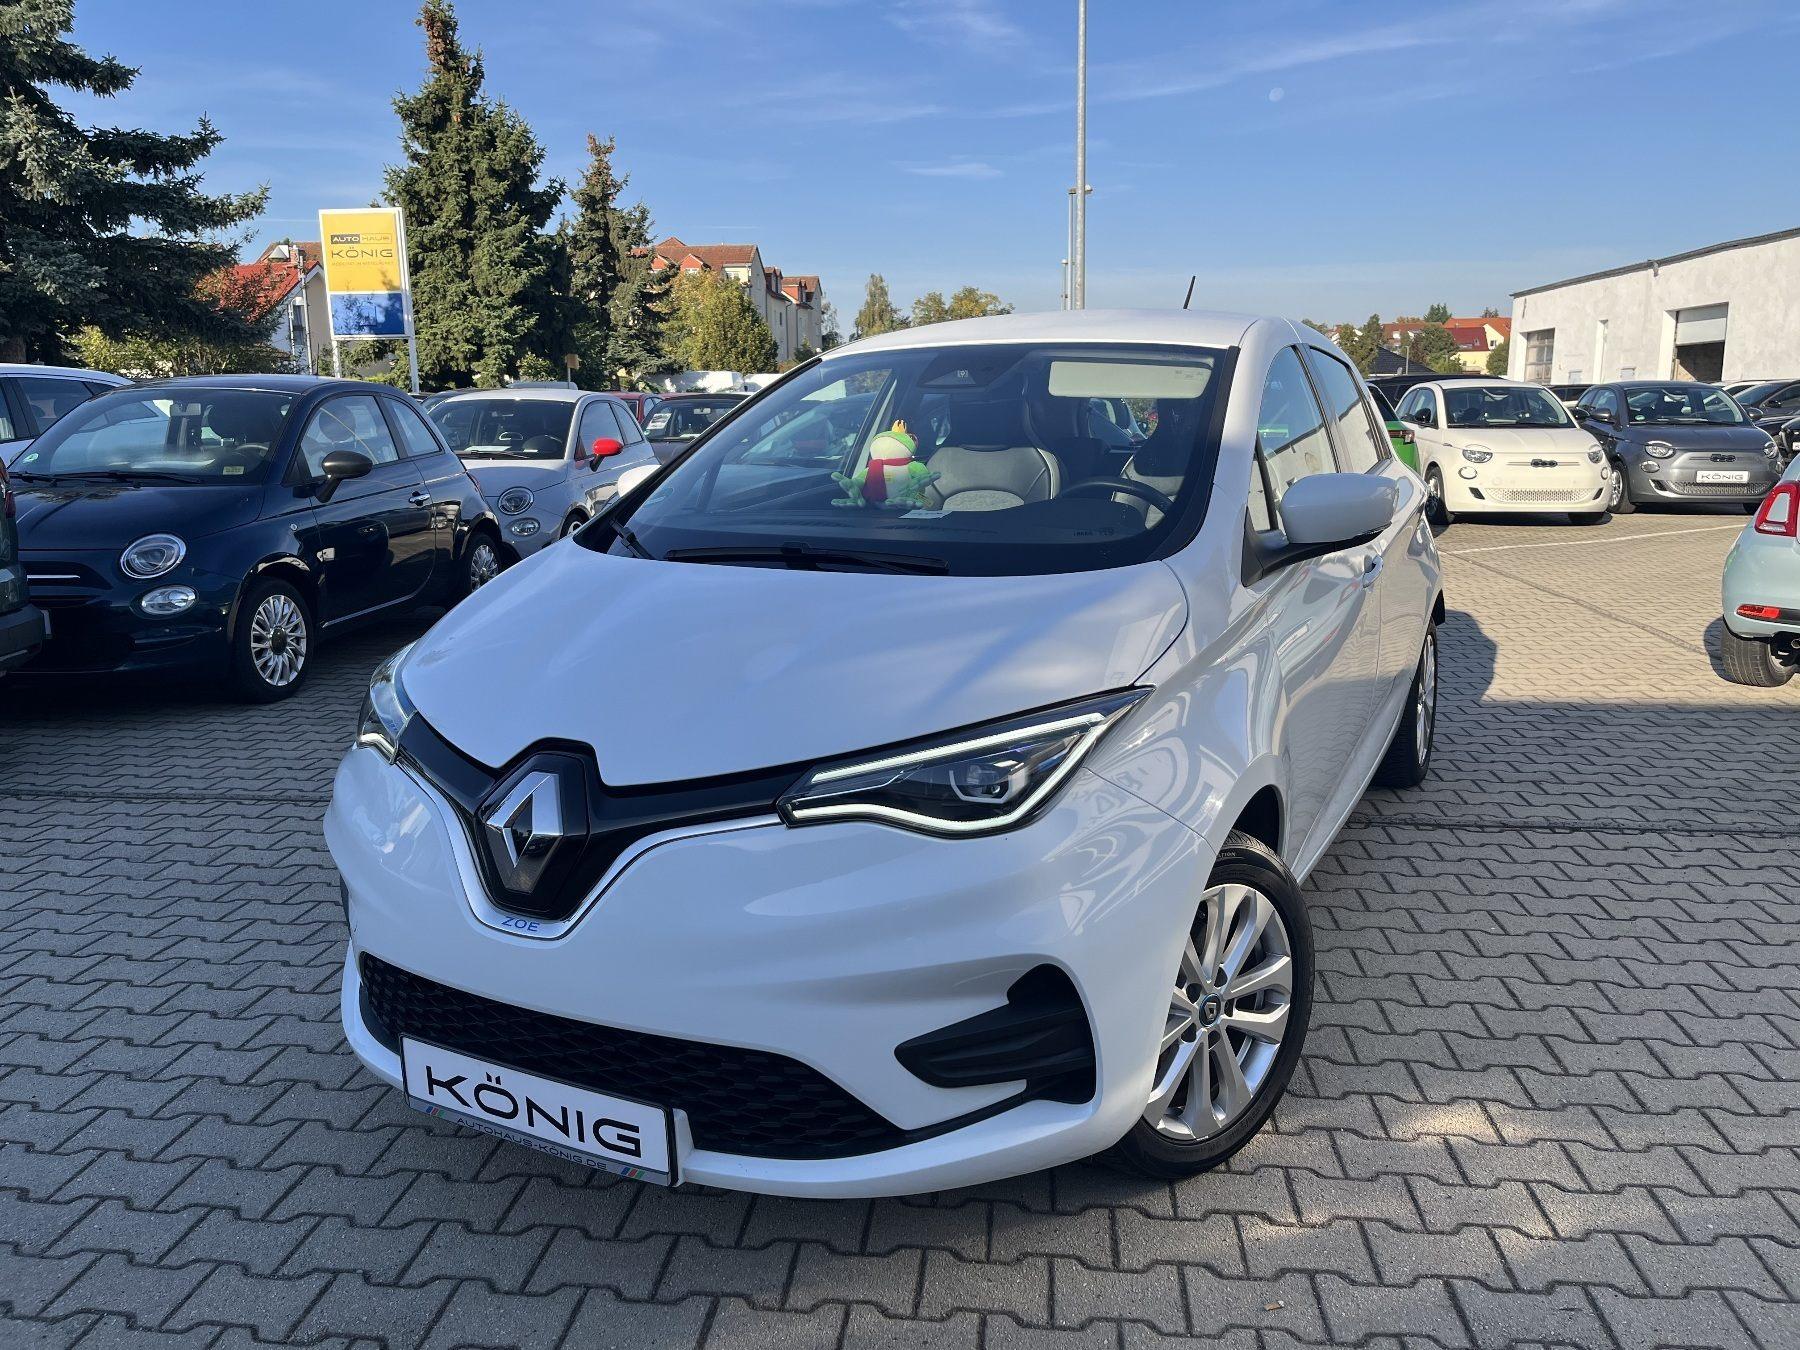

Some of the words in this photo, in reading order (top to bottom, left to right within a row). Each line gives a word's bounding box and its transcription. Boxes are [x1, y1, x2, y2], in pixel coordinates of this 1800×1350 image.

[331, 247, 393, 258] KÖNIG
[501, 916, 540, 932] ZOE
[425, 1065, 642, 1158] KÖNIG
